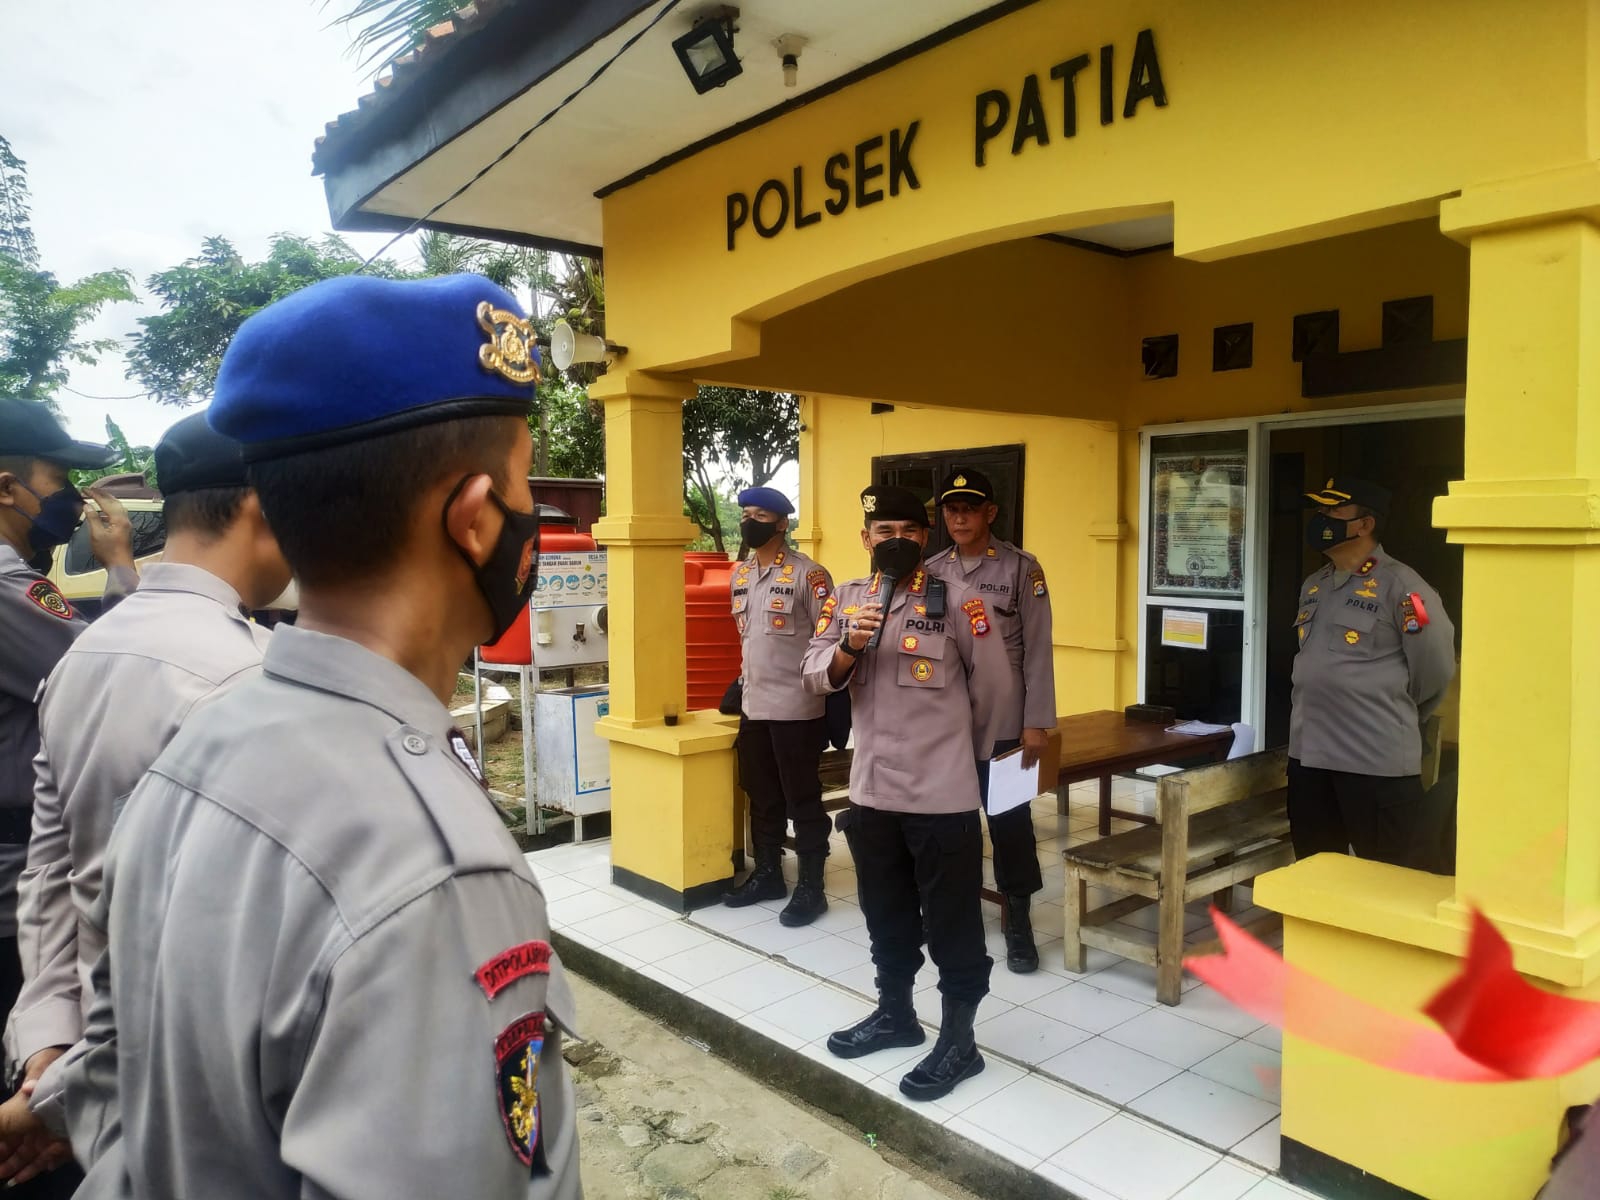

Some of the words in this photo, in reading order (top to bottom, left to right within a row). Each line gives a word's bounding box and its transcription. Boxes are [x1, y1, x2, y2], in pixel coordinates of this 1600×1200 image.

[727, 121, 921, 251] POLSEK
[974, 28, 1168, 167] PATIA
[769, 586, 794, 596] POLRI
[979, 583, 1010, 594] POLRI
[1345, 598, 1378, 613] POLRI
[905, 619, 945, 633] POLRI
